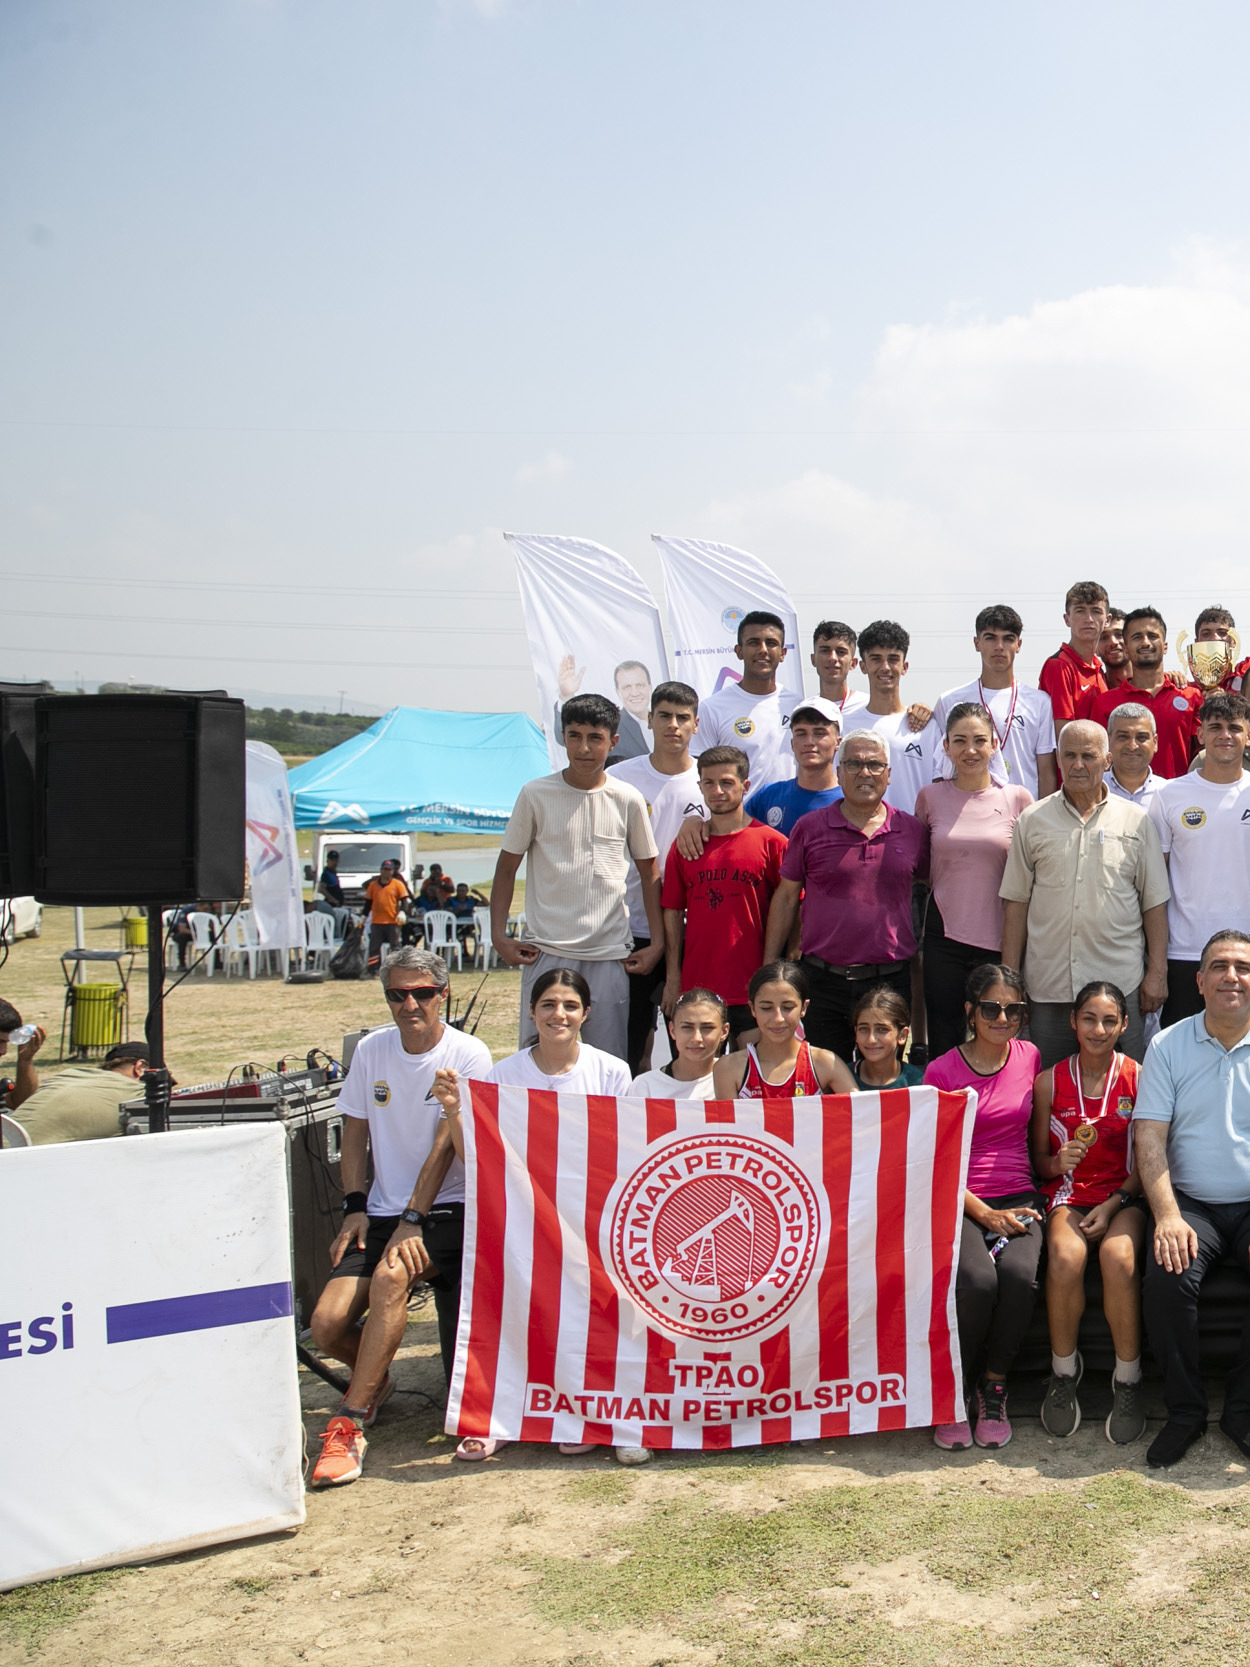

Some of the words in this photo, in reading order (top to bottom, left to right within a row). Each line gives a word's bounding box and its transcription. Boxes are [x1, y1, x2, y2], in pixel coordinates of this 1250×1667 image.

[421, 803, 471, 816] MERSİN
[405, 815, 442, 825] GENÇLİK
[456, 819, 479, 827] SPOR
[698, 868, 727, 884] POLO
[628, 1164, 682, 1292] BATMAN
[684, 1152, 804, 1289] PETROLSPOR
[679, 1303, 749, 1325] 1960
[674, 1365, 760, 1389] TPAO
[530, 1389, 670, 1421] BATMAN
[683, 1378, 900, 1422] PETROLSPOR
